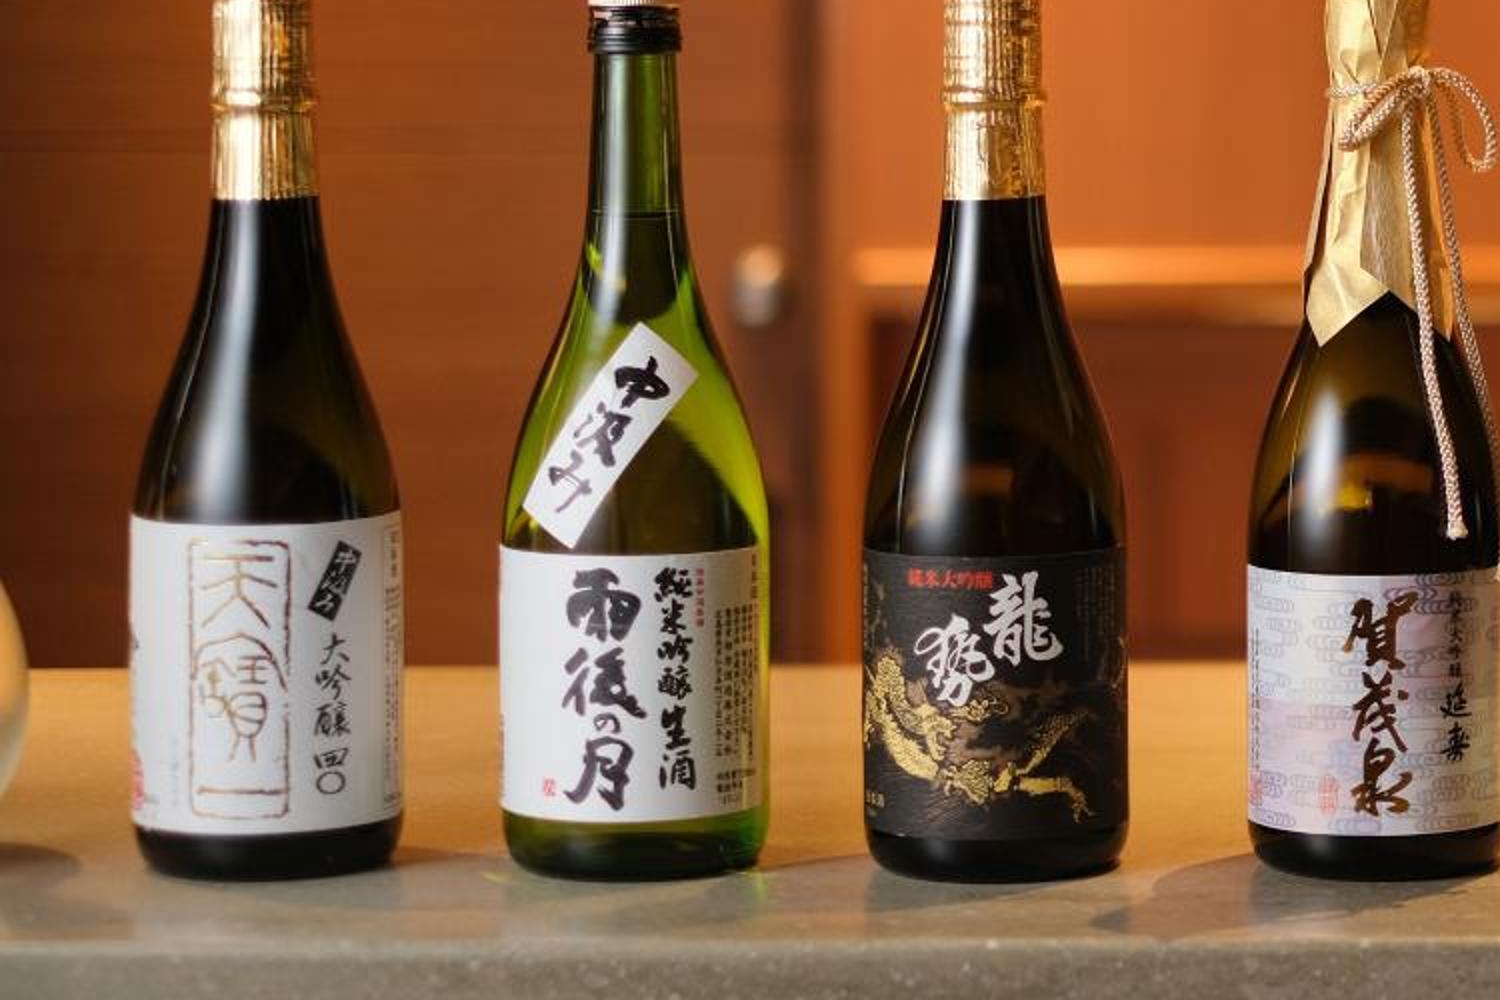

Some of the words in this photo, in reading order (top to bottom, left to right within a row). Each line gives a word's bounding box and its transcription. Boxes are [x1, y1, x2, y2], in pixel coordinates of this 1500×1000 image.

[561, 567, 649, 812] 雨後の月
[1343, 590, 1420, 817] 賀茂泉
